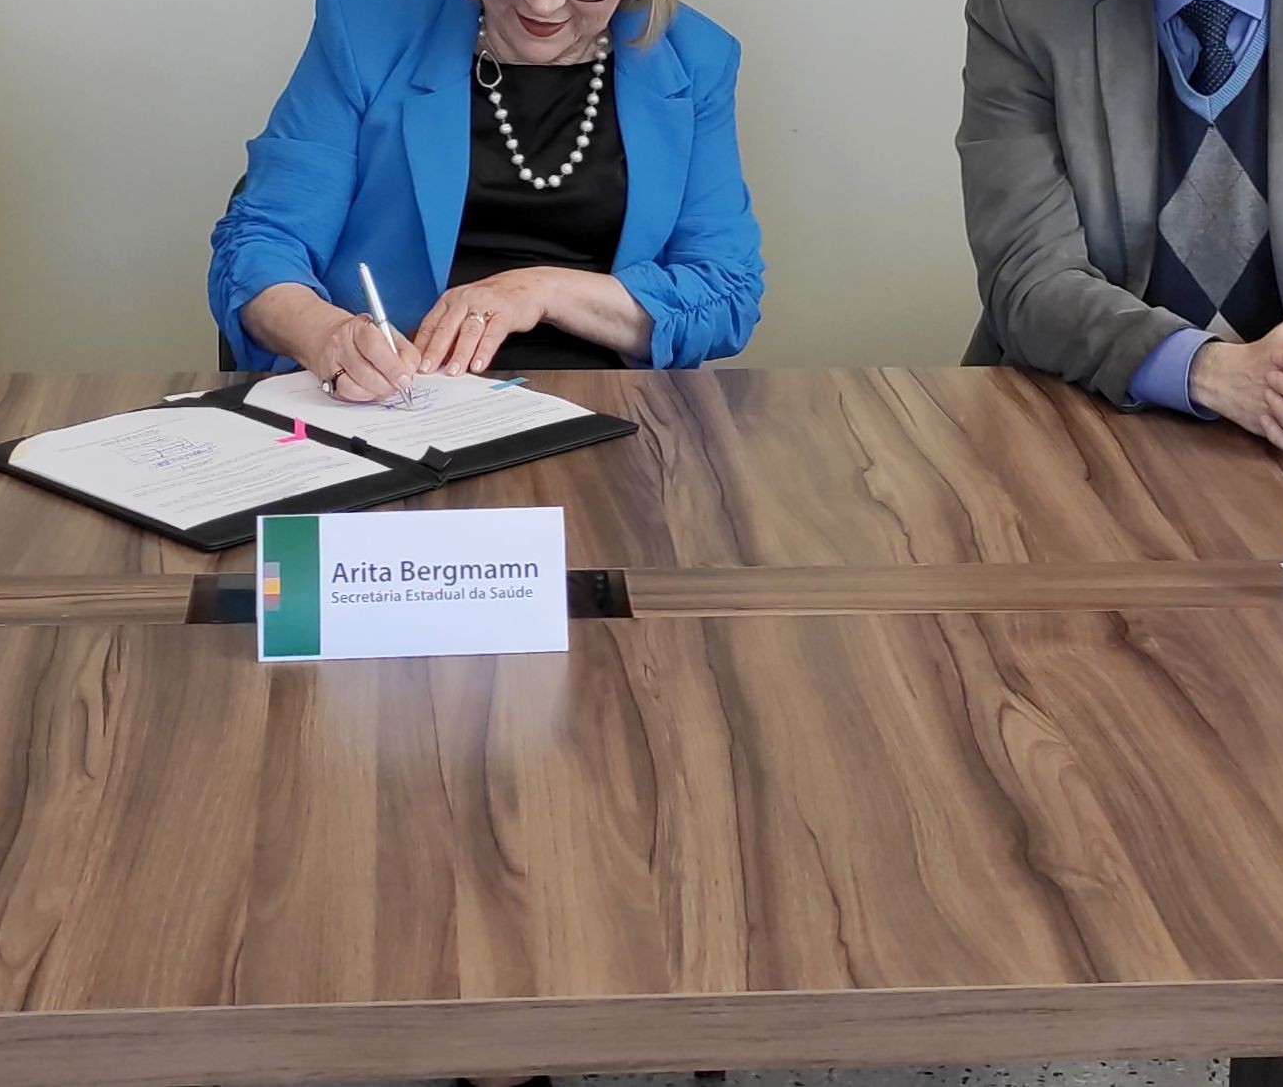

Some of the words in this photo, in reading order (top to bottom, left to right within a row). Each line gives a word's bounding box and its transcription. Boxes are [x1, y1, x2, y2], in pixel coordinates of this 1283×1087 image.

[331, 562, 392, 584] Arita
[401, 561, 539, 586] Bergmamn
[330, 589, 402, 604] Secretária
[405, 587, 465, 602] Estadual
[468, 586, 486, 600] da
[489, 585, 533, 600] Saúde
